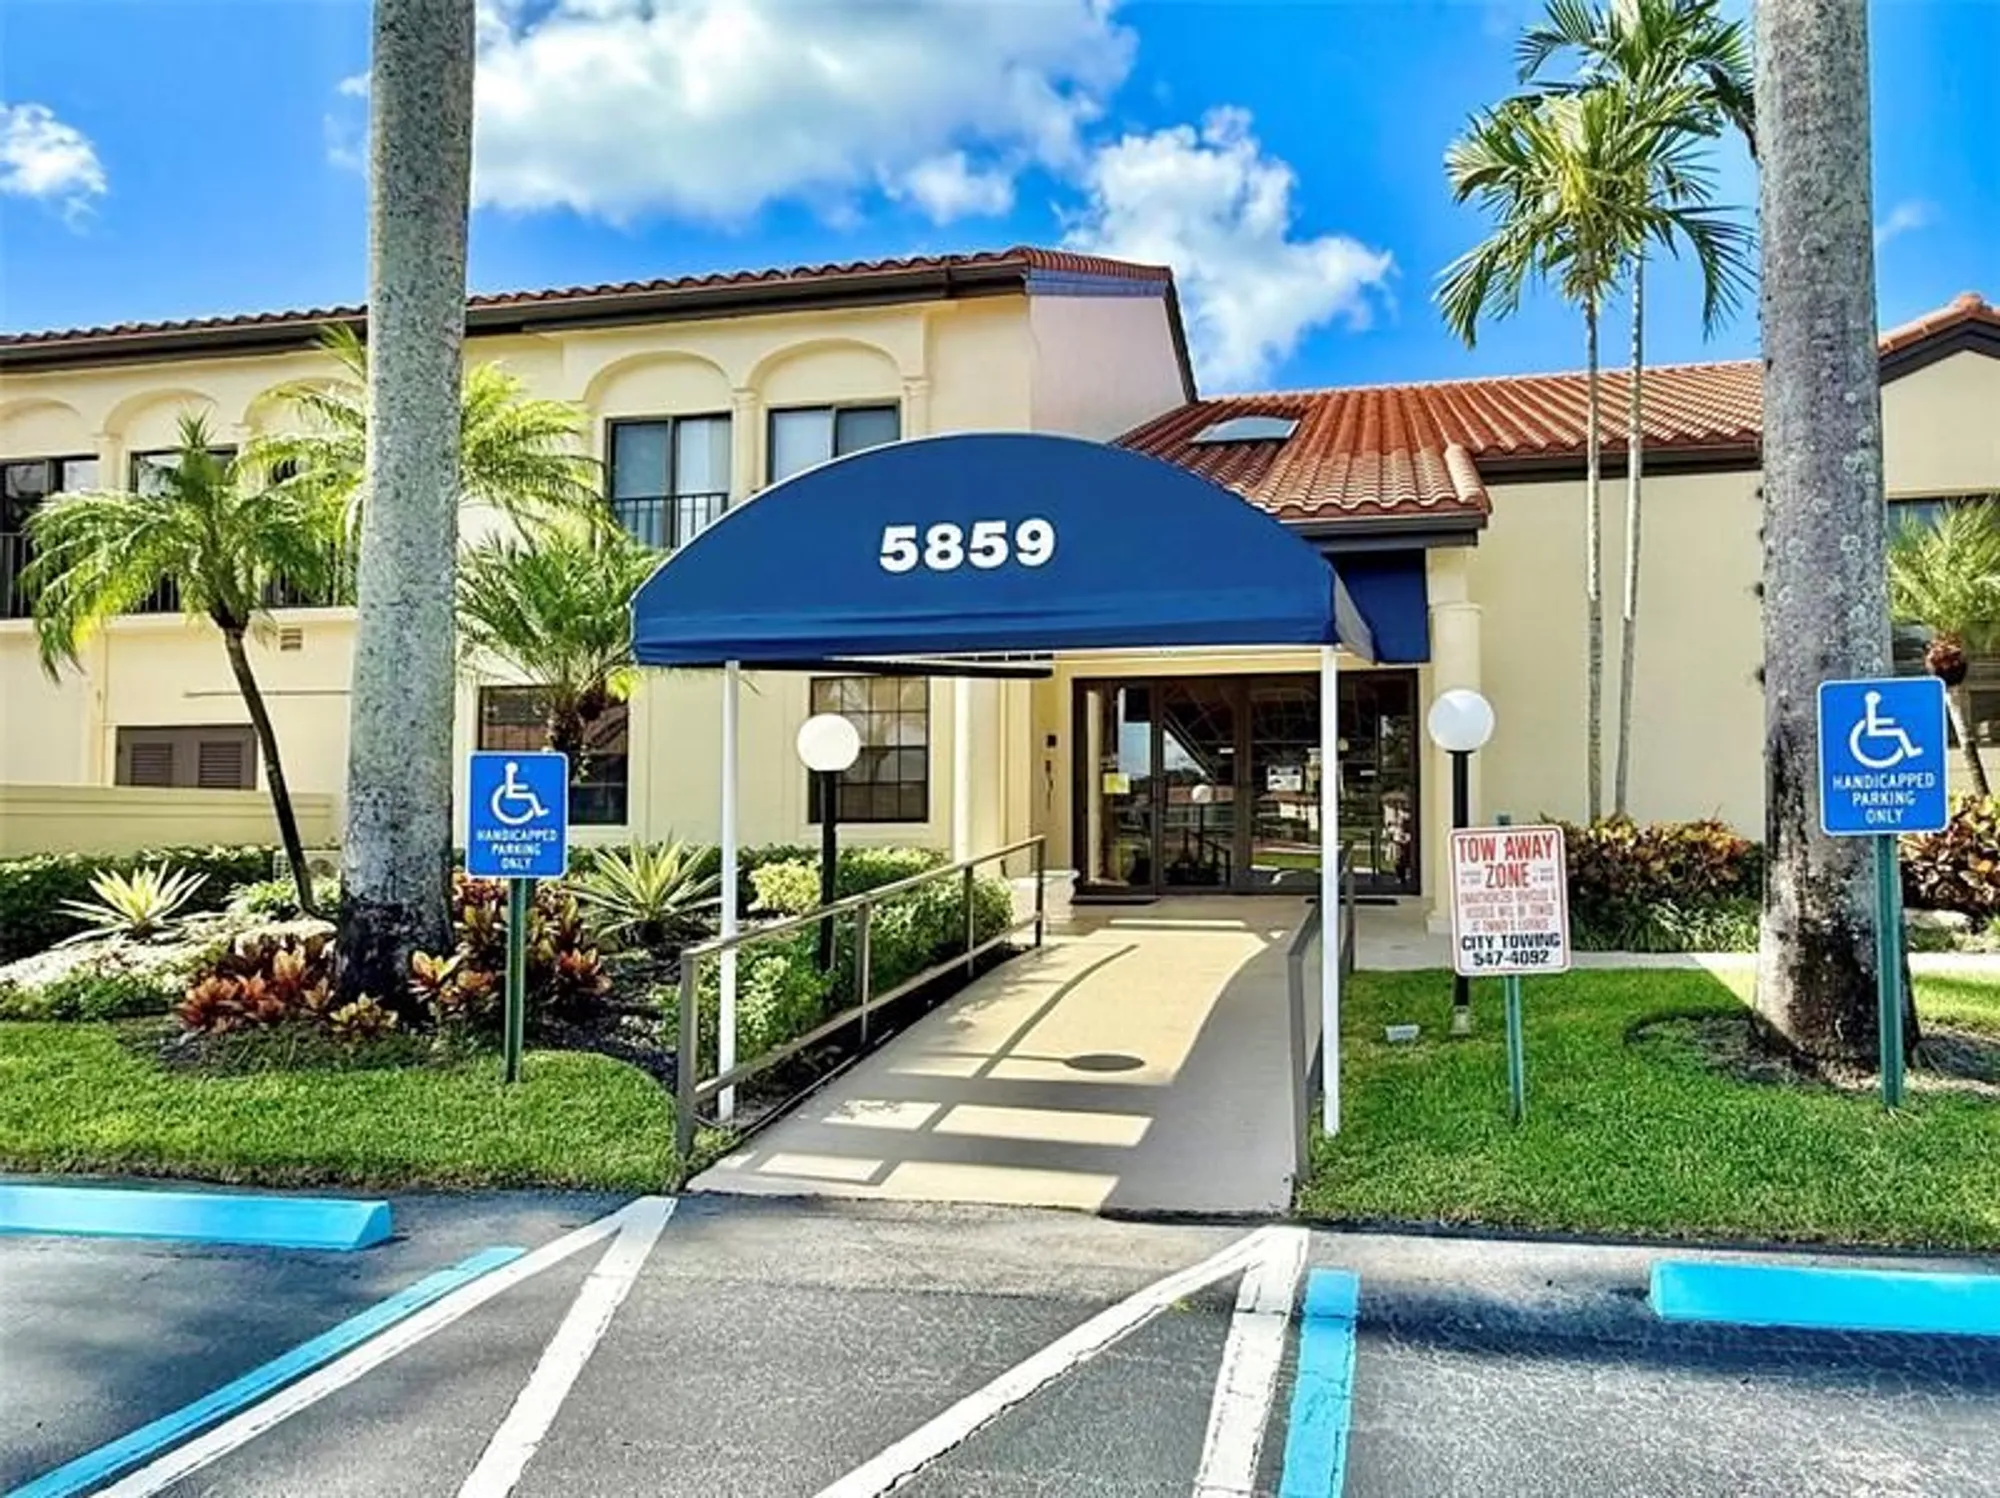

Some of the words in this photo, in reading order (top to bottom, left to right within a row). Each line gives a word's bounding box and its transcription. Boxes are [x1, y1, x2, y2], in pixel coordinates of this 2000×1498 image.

[880, 517, 1055, 572] 5859
[1832, 772, 1935, 791] HANDICAPPED
[1852, 790, 1916, 807] PARKING
[1865, 808, 1904, 824] ONLY
[476, 829, 557, 842] HANDICAPPED
[491, 843, 542, 857] PARKING
[1458, 836, 1497, 862] TOW
[1504, 834, 1554, 861] AWAY
[500, 857, 533, 870] ONLY
[1484, 862, 1530, 888] ZONE
[1461, 935, 1494, 951] CITY
[1502, 932, 1561, 948] TOWING
[1473, 950, 1550, 966] 547-4092
